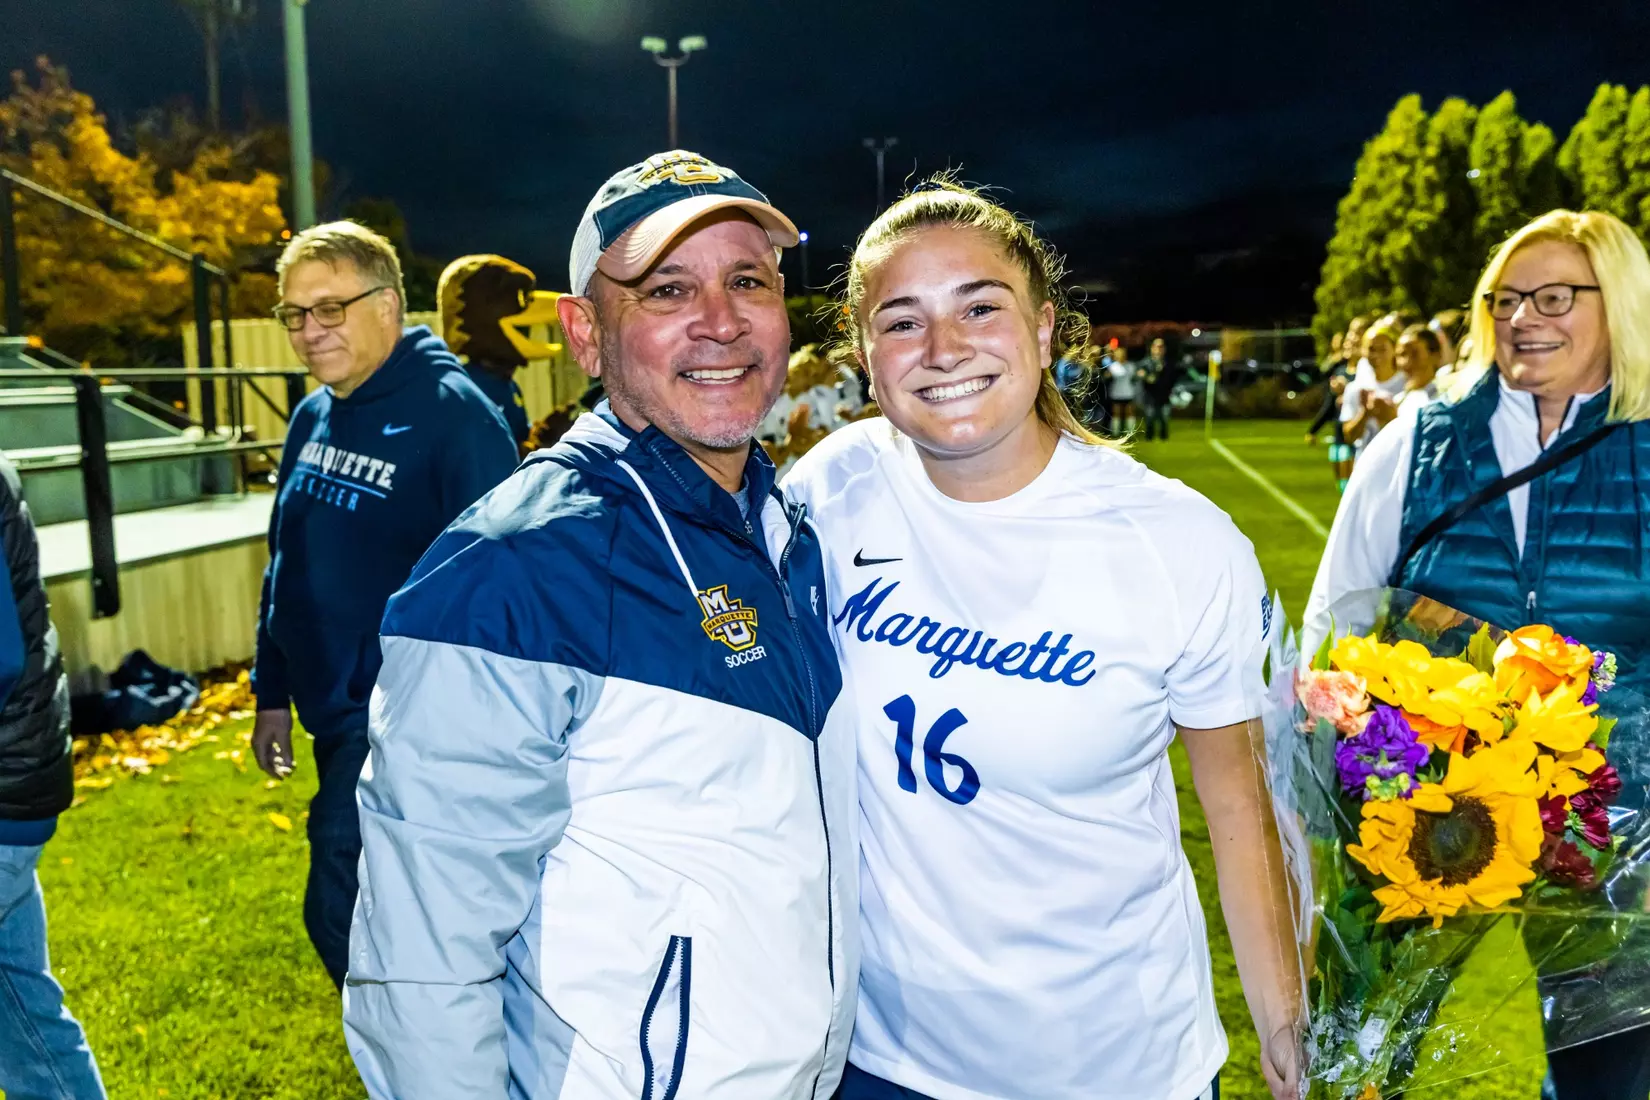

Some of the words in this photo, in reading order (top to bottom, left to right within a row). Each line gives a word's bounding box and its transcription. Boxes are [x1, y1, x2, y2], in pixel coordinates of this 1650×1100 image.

[706, 611, 752, 630] MARQUETTE
[832, 577, 1096, 687] Marquette
[725, 646, 766, 668] SOCCER
[883, 694, 981, 805] 16
